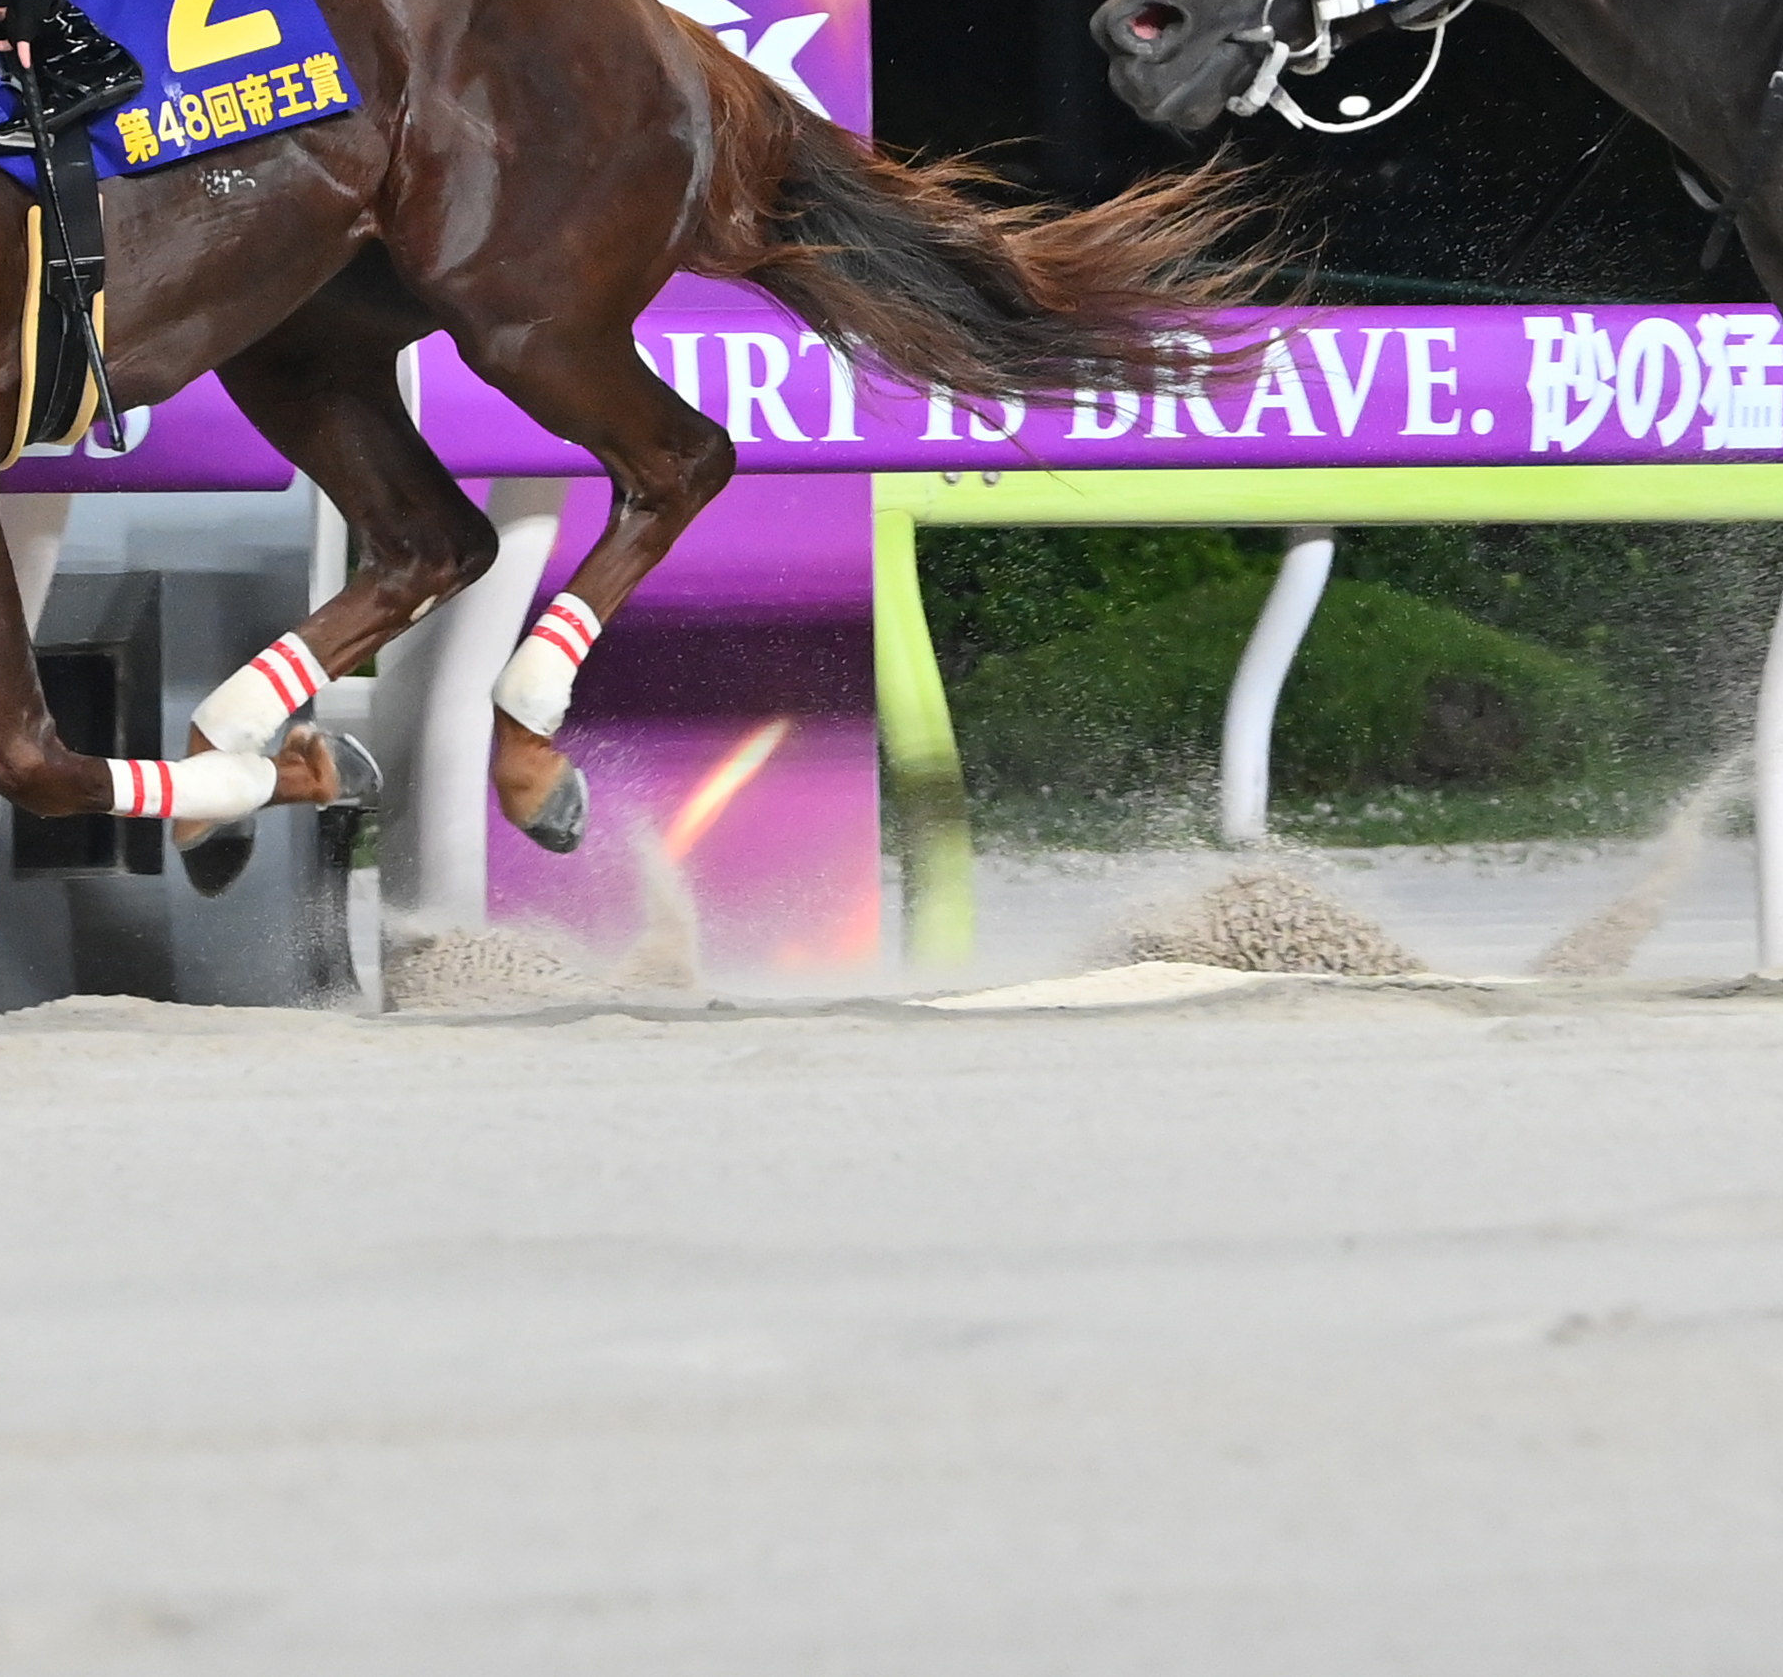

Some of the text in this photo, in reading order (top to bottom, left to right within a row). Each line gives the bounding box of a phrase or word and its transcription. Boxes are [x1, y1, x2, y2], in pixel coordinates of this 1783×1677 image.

[115, 52, 348, 165] 第48回帝王賞
[633, 332, 866, 443] IRT
